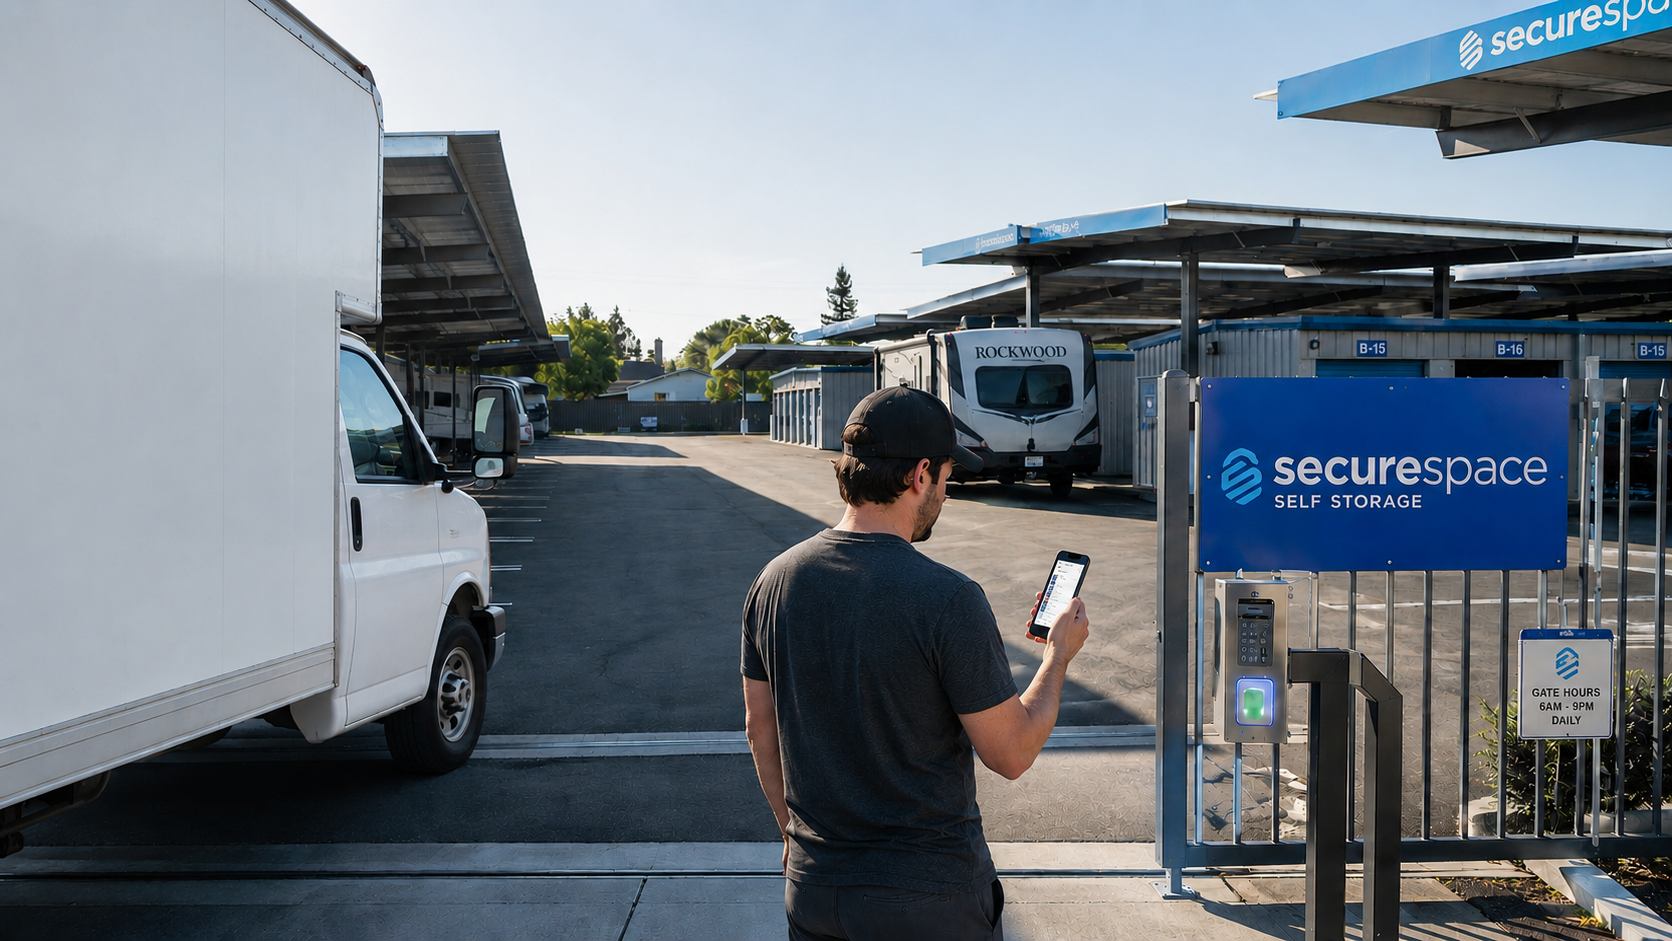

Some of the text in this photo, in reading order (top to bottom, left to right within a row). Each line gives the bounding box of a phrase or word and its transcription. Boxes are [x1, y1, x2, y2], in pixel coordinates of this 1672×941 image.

[975, 345, 1066, 359] ROCKWOOD
[1359, 343, 1386, 354] B-15
[1497, 344, 1523, 355] B-16
[1640, 345, 1665, 356] B-15
[1273, 456, 1548, 495] securespace
[1274, 494, 1422, 509] SELF STORAGE
[1532, 688, 1601, 698] GATE HOURS
[1539, 702, 1562, 711] 6AM
[1572, 702, 1594, 711] 9PM
[1551, 716, 1582, 725] DAILY
